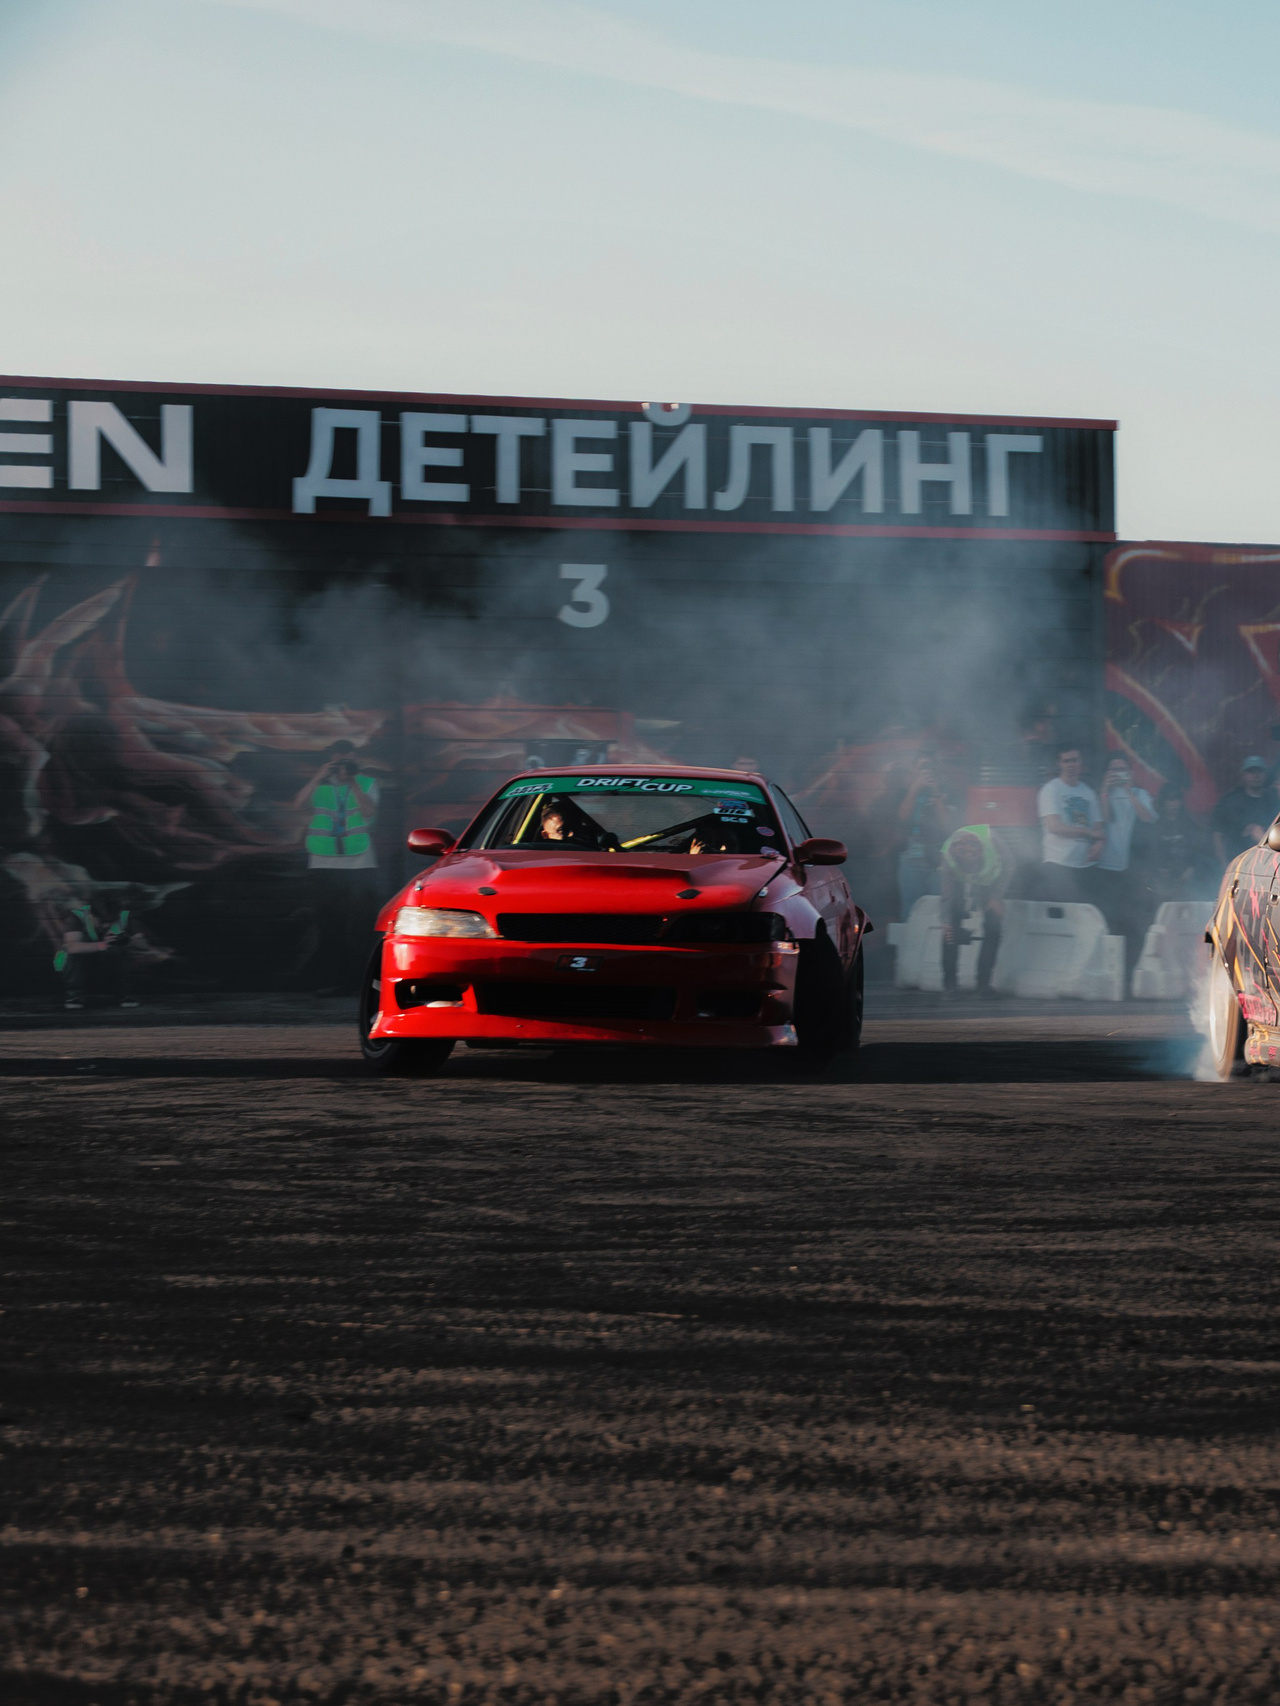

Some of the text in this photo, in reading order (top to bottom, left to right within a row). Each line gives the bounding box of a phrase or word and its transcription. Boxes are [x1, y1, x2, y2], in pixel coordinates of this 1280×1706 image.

[292, 403, 1043, 517] ДЕТЕЙЛИНГ
[558, 564, 610, 628] 3
[576, 778, 693, 792] DRIFT CUP
